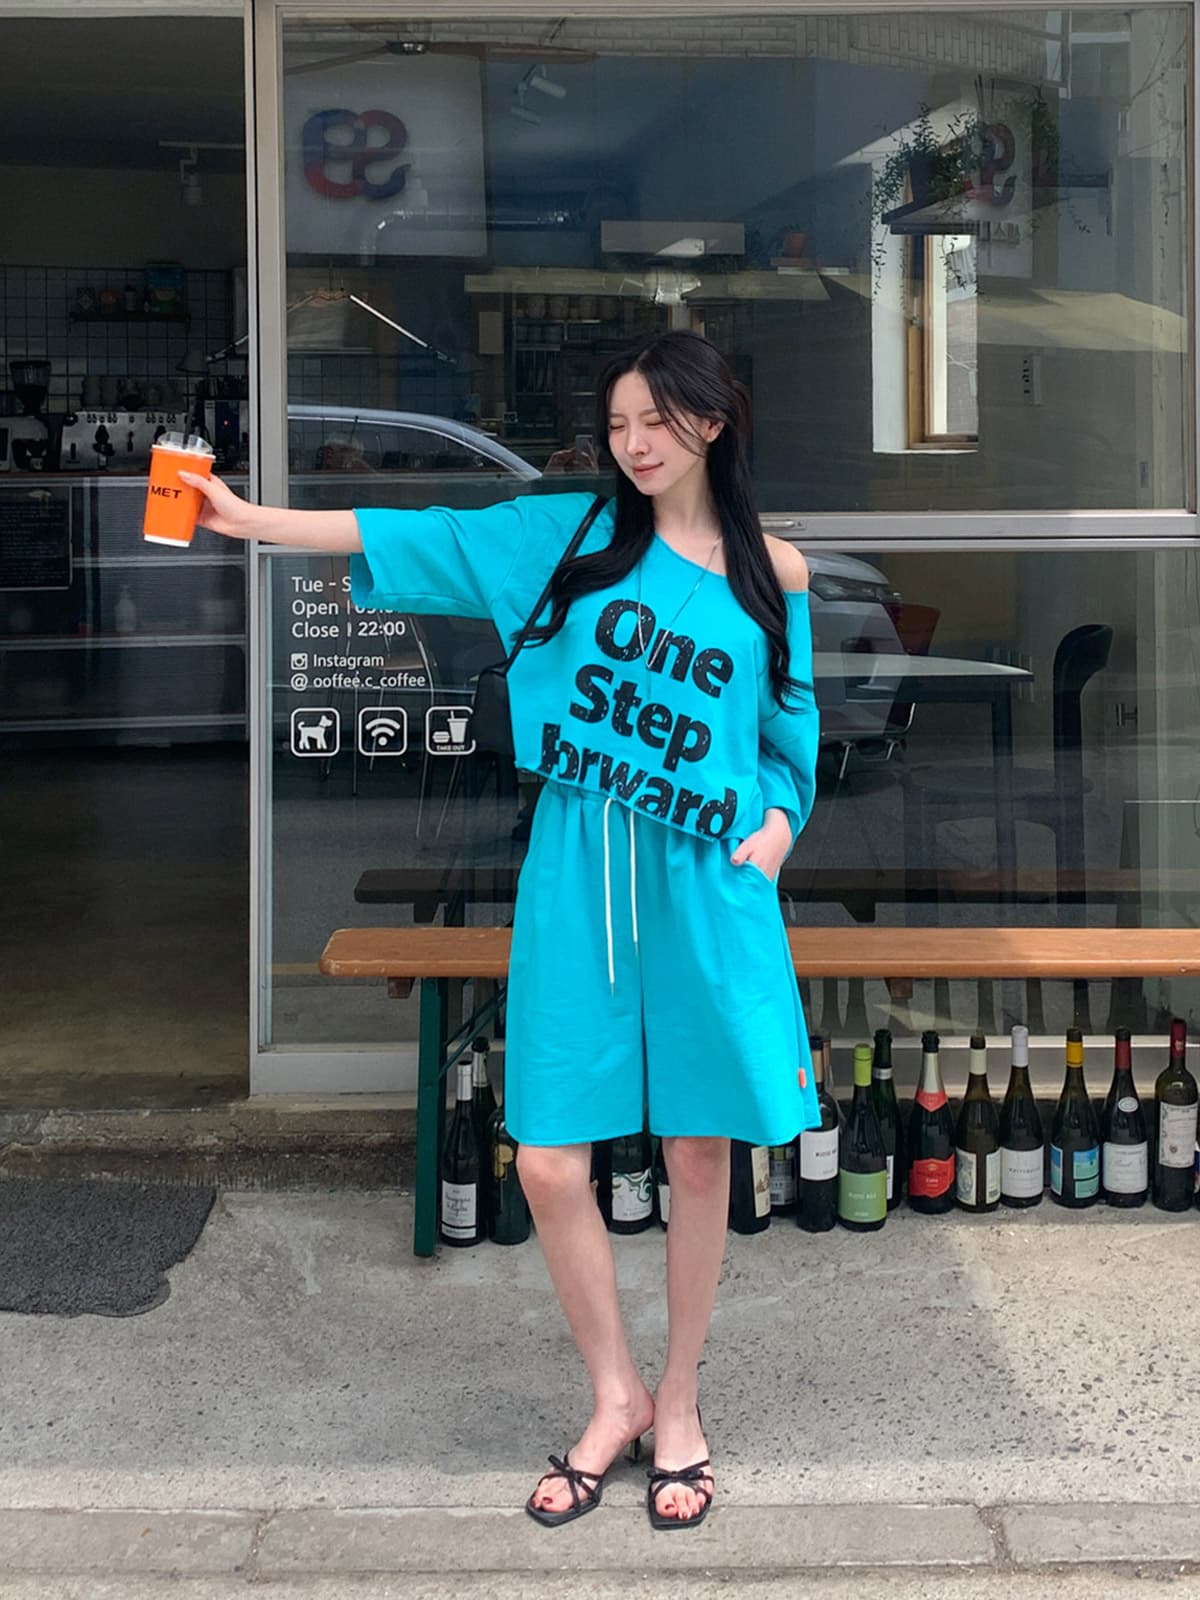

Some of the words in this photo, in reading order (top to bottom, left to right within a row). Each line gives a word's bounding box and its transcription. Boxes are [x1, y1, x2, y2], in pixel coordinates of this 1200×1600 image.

[151, 485, 182, 499] MET
[291, 576, 324, 592] Tue
[292, 599, 339, 619] Open
[292, 621, 340, 638] Close
[358, 621, 405, 637] 22:00
[594, 598, 734, 698] One
[313, 654, 384, 670] Instagram
[569, 663, 712, 772] Step
